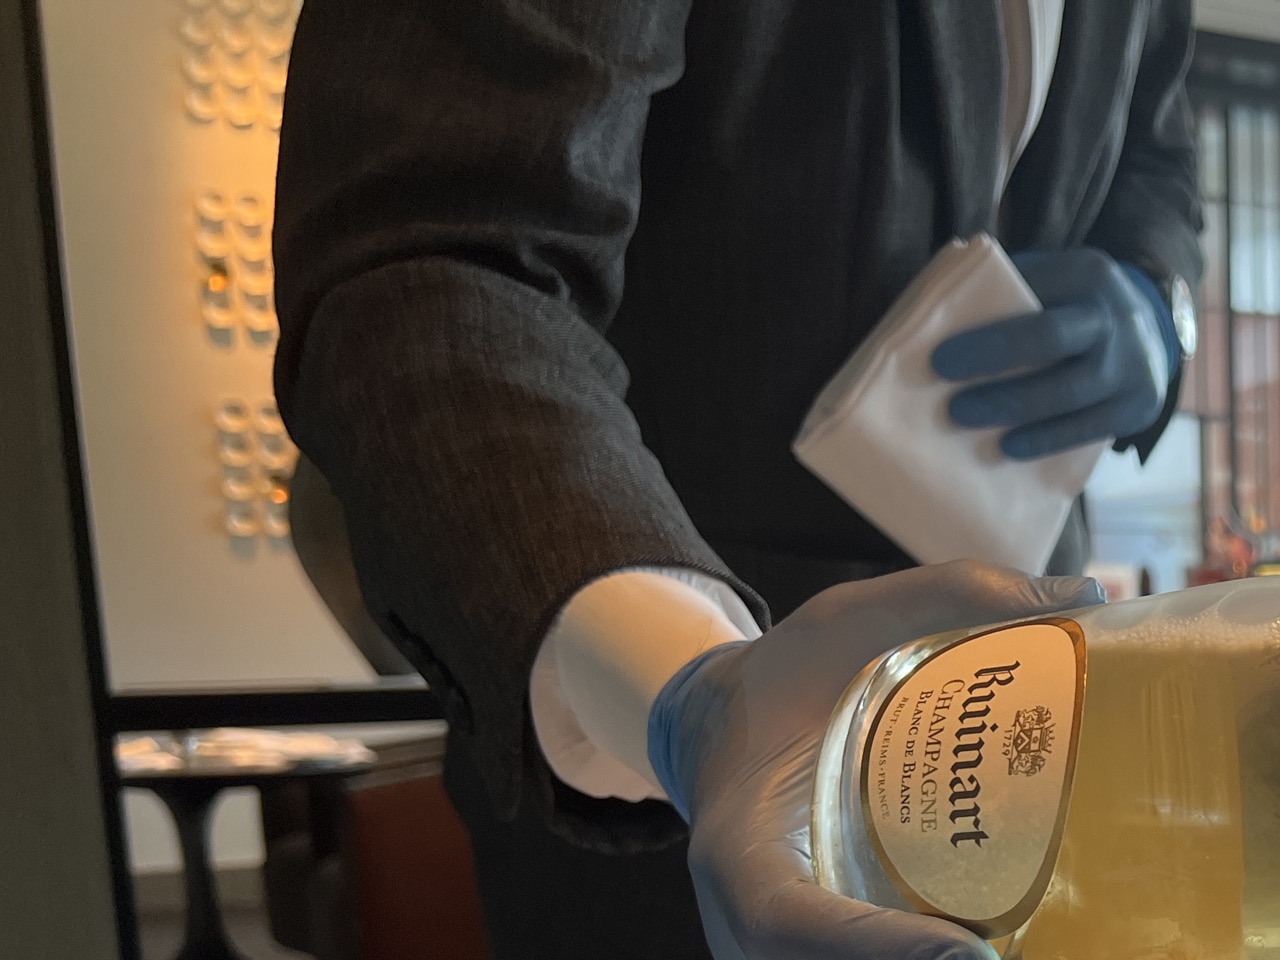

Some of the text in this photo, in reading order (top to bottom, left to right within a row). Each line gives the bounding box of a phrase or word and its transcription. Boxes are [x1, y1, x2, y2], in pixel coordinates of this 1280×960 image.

[877, 771, 890, 820] FRANCE
[900, 689, 934, 824] BLANC DE BLANCS
[921, 679, 966, 833] CHAMPAGNE
[949, 660, 1020, 848] Ruinart
[1002, 729, 1014, 757] 1729
